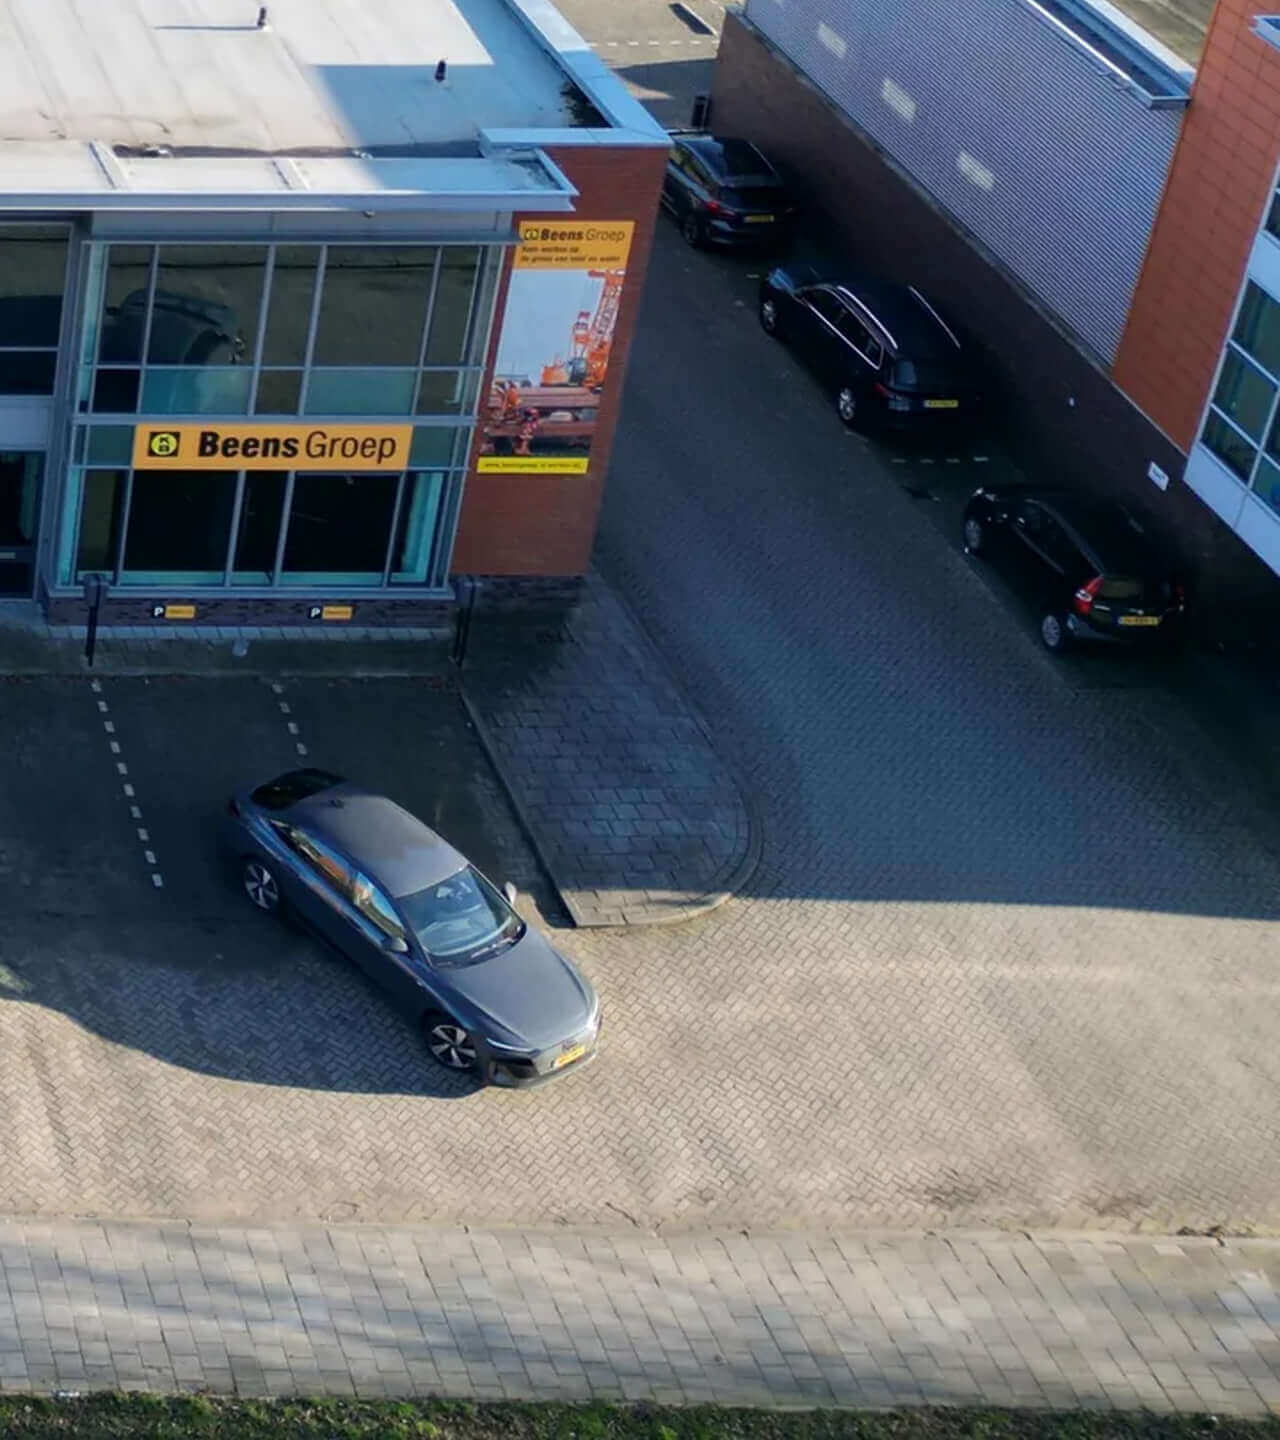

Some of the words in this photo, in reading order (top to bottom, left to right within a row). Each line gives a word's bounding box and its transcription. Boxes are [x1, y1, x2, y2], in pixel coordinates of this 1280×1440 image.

[540, 227, 584, 241] Beens
[585, 228, 625, 244] Groep
[197, 430, 300, 459] Beens
[304, 430, 397, 465] Groep
